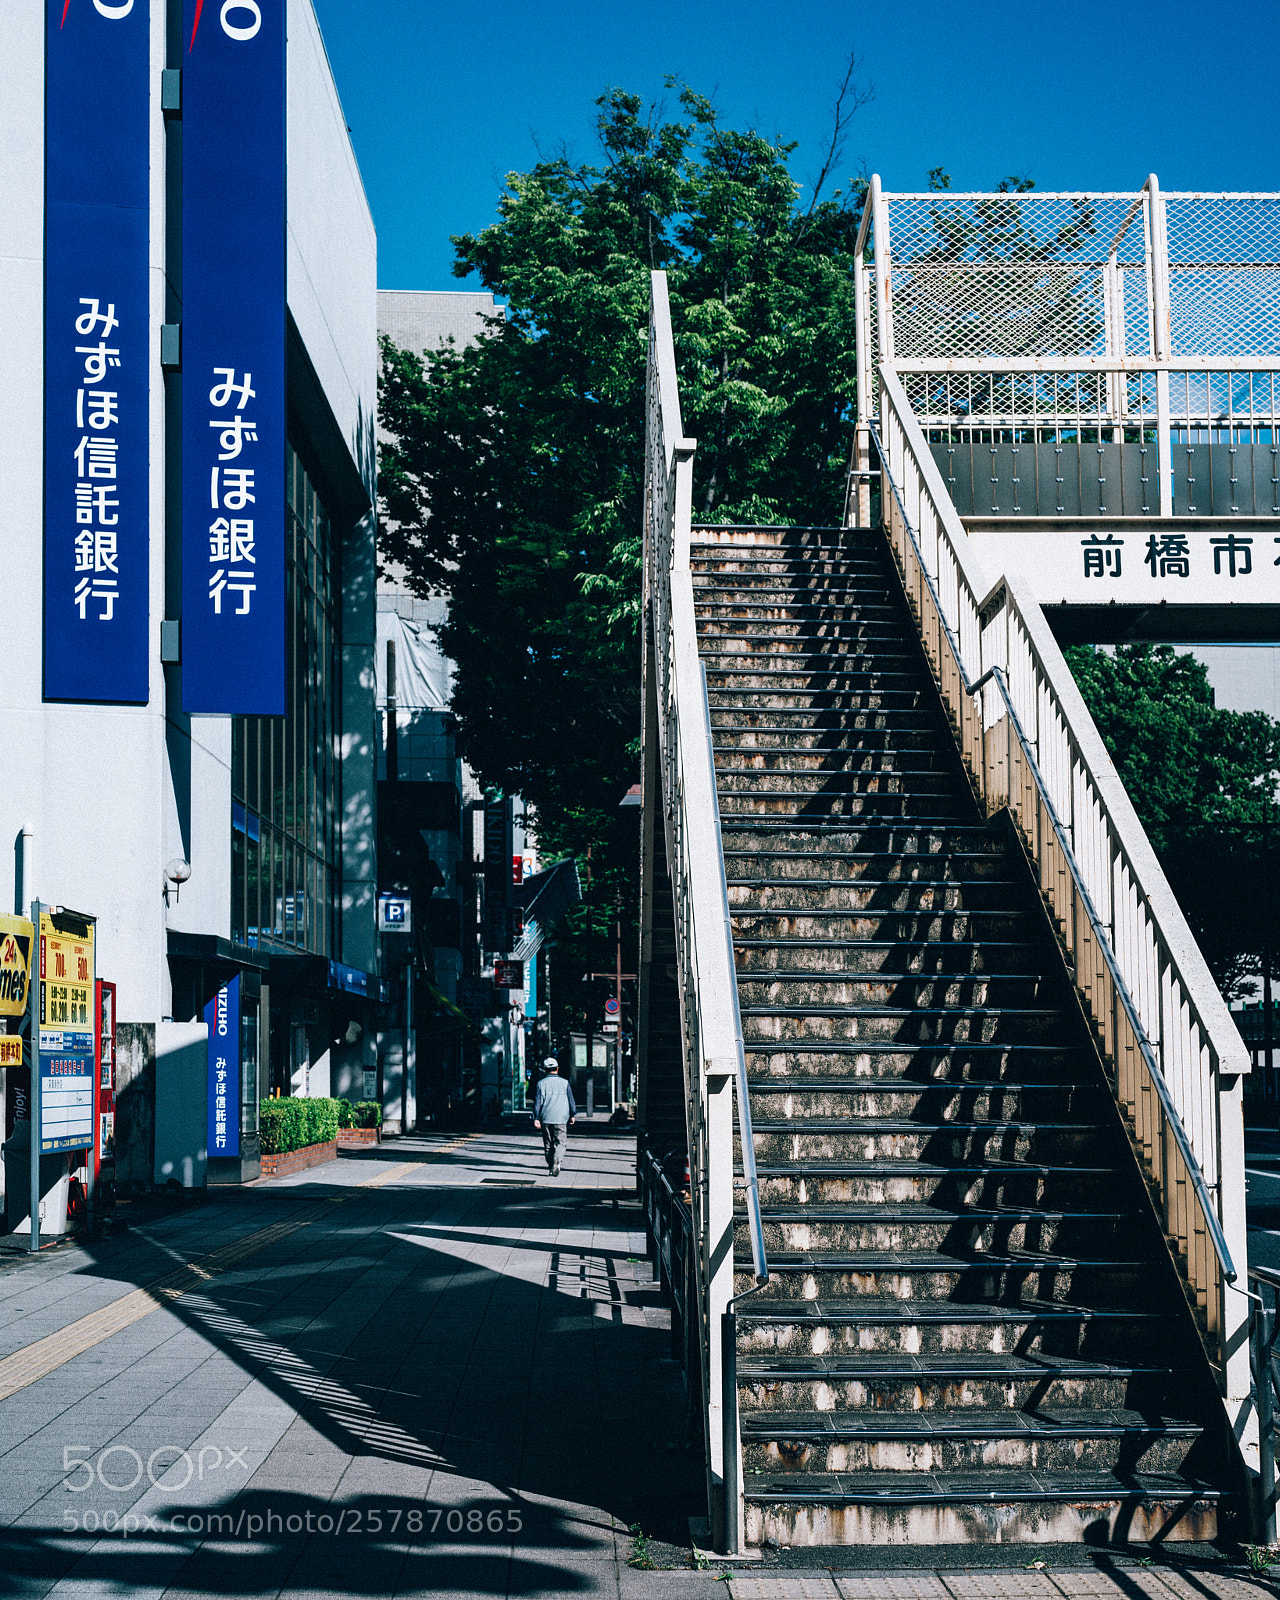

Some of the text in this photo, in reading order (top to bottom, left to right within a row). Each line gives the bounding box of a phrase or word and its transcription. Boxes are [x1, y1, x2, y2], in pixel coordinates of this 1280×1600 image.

[74, 298, 121, 621] みずほ信託銀行
[209, 367, 258, 616] みずほ銀行
[1081, 534, 1280, 578] 前橋市
[389, 905, 402, 920] P
[215, 1057, 227, 1148] みずほ信託銀行
